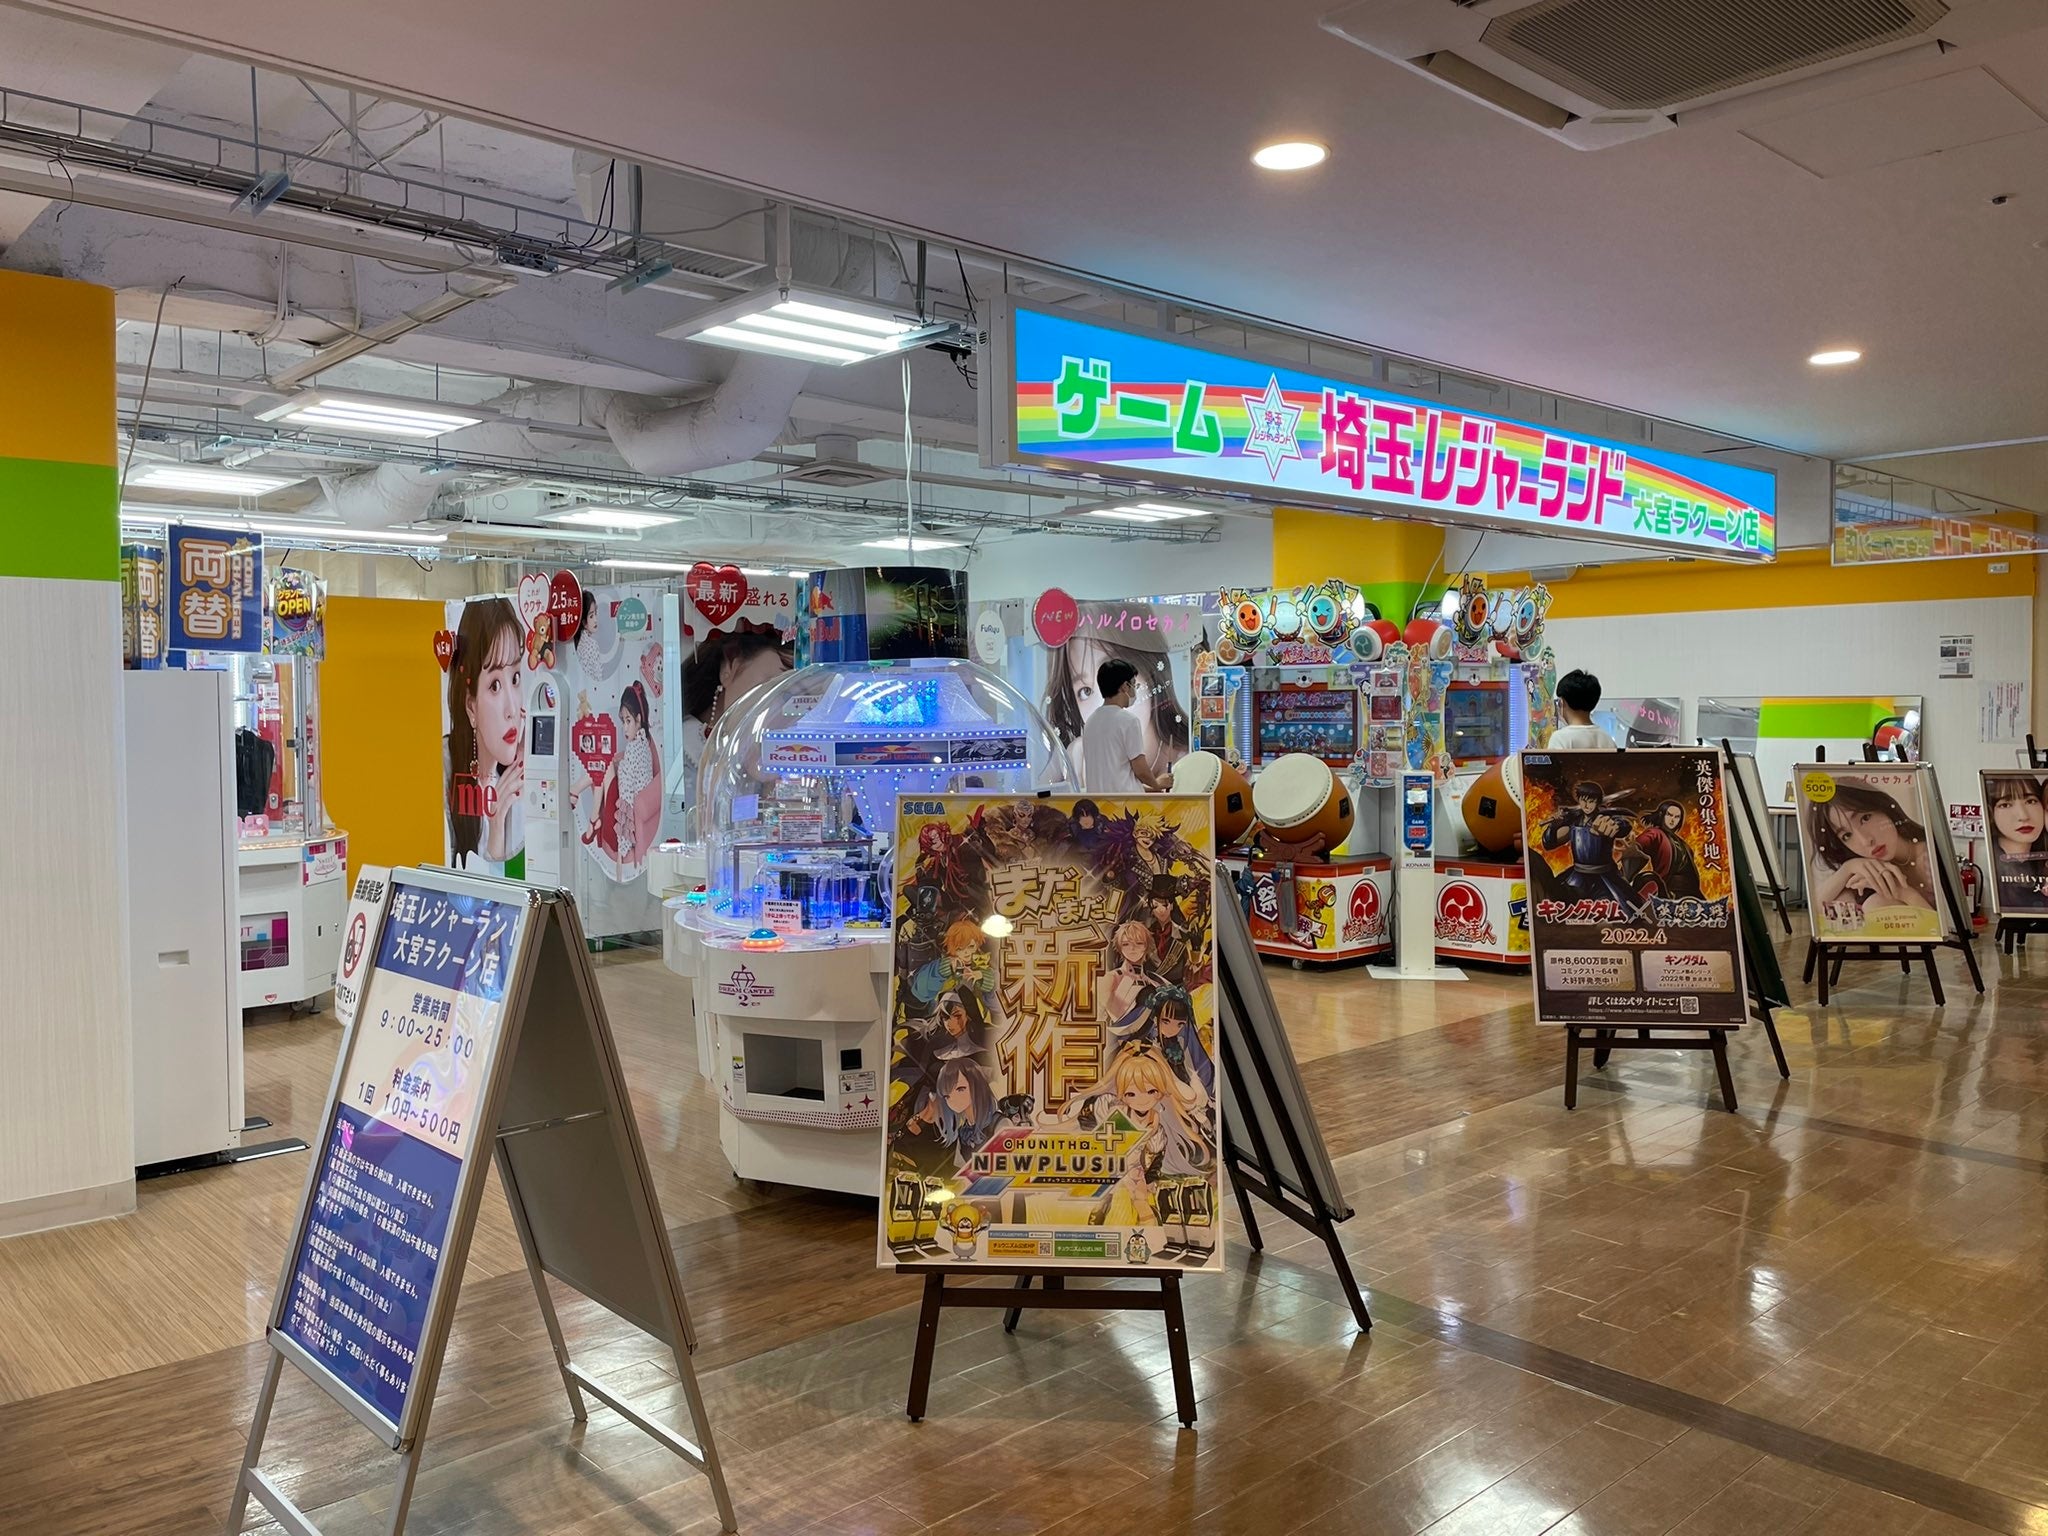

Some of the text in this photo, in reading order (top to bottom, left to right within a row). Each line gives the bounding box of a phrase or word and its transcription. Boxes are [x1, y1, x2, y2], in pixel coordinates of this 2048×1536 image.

[1055, 357, 1759, 550] ゲーム 埼玉レジャーランド 大宮ラクーン店
[181, 541, 230, 637] 両替
[695, 580, 738, 604] 最新
[277, 597, 312, 616] OPEN
[708, 603, 728, 616] プリ
[1041, 611, 1074, 623] NEW
[436, 642, 451, 656] NEW
[769, 753, 828, 763] Red Bull
[1524, 755, 1552, 765] SEGA
[1805, 783, 1833, 793] 500円
[457, 781, 498, 817] me
[904, 801, 946, 816] SEGA
[1694, 759, 1723, 872] 英傑の集う地へ
[1951, 805, 1981, 815] 消火
[1537, 899, 1628, 924] キングダム
[1601, 928, 1667, 945] 2022.4
[392, 930, 501, 987] 大宮ラクーン店
[1664, 954, 1708, 966] キングダム
[411, 992, 451, 1024] 営業時間
[997, 922, 1113, 1108] 新作
[393, 1067, 432, 1102] 料金案内
